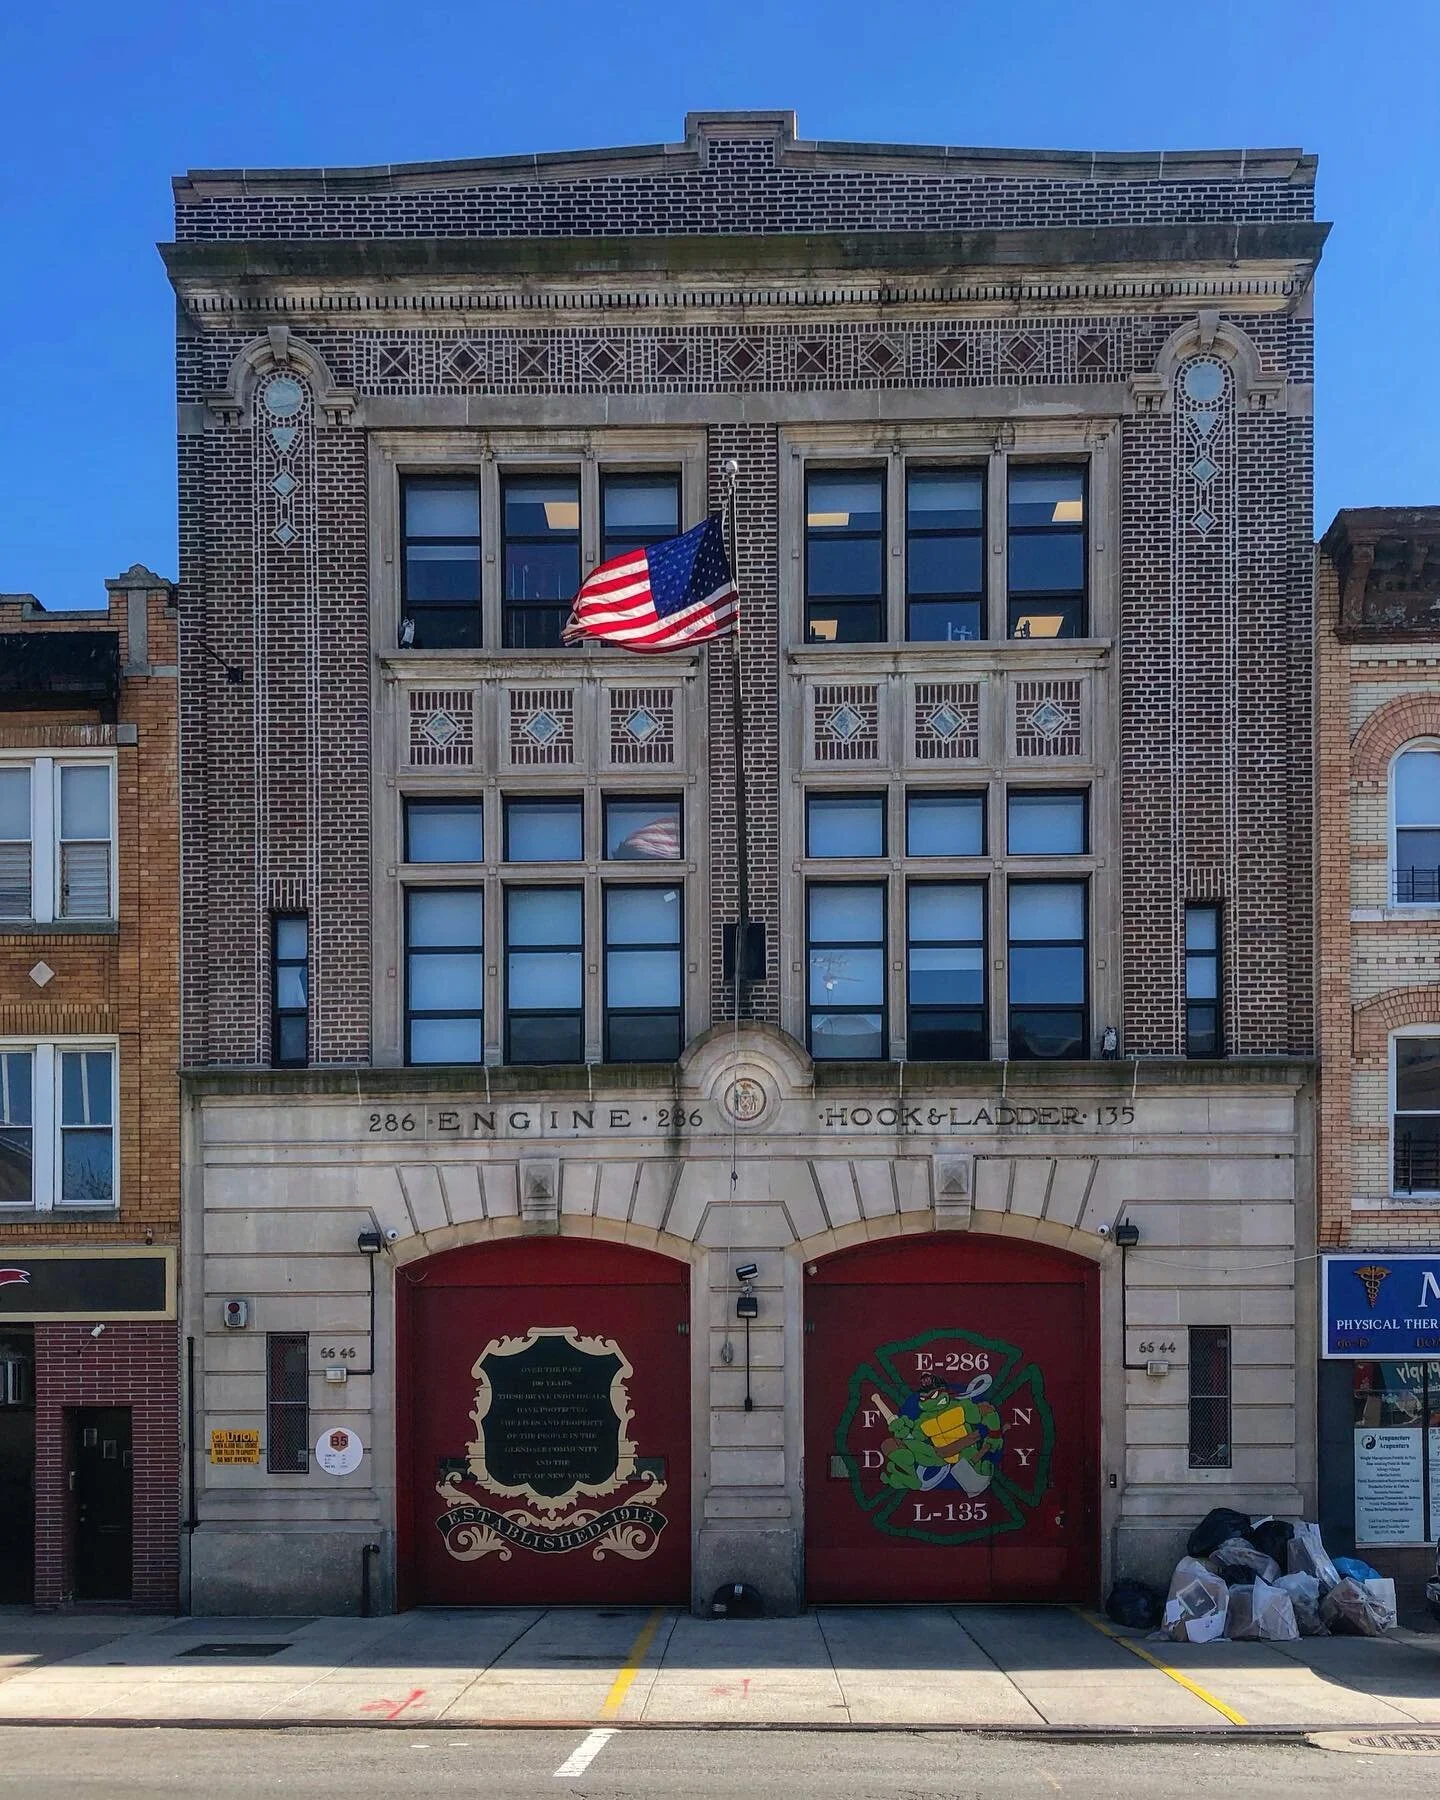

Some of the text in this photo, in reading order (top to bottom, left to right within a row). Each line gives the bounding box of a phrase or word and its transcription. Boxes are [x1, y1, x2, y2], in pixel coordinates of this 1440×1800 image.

[369, 1113, 415, 1131] 286
[658, 1108, 703, 1127] 286
[1096, 1107, 1134, 1126] 135
[1336, 1318, 1439, 1331] PHYSICAL THER
[915, 1352, 989, 1371] E-286
[331, 1435, 347, 1447] B5
[913, 1503, 988, 1522] L-135
